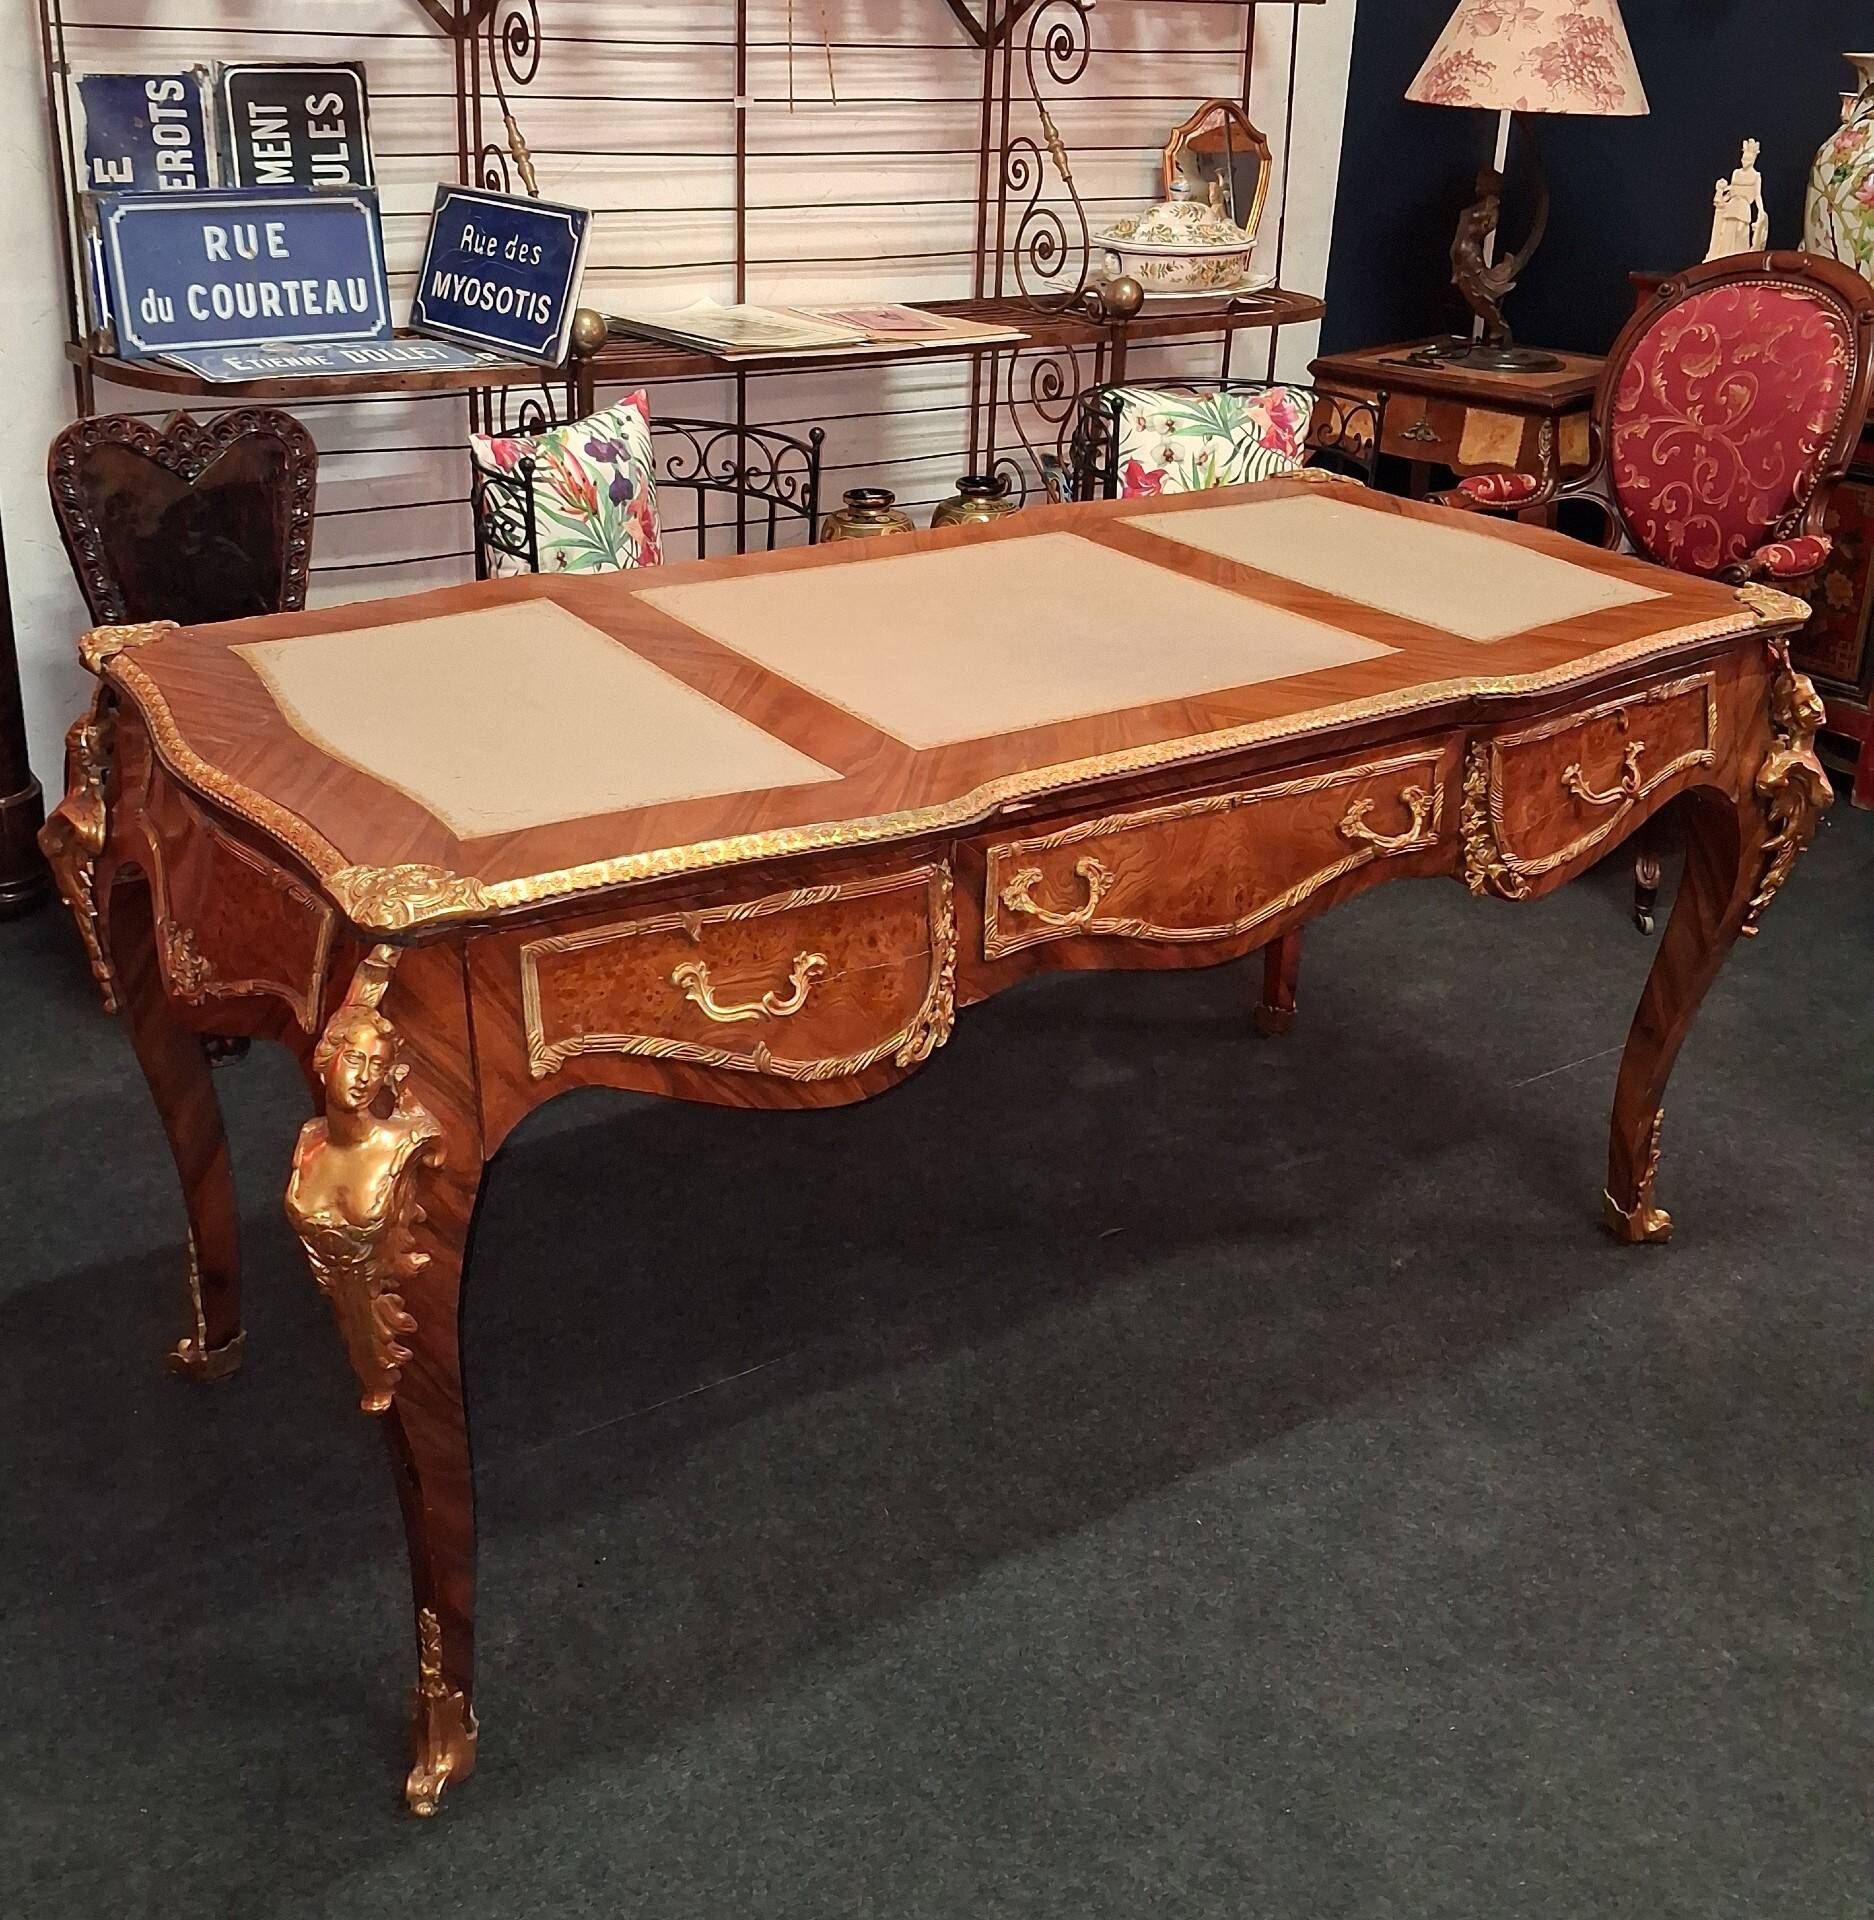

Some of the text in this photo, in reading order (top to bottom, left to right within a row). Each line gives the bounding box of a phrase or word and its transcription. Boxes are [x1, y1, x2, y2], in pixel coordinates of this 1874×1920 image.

[145, 79, 197, 190] EROTS
[247, 101, 295, 184] MENT
[305, 92, 350, 187] ULES
[93, 156, 134, 184] E
[203, 222, 290, 262] RUE
[460, 224, 543, 265] Rue des
[140, 277, 369, 324] du COURTEAU
[431, 271, 552, 324] MYOSOTIS
